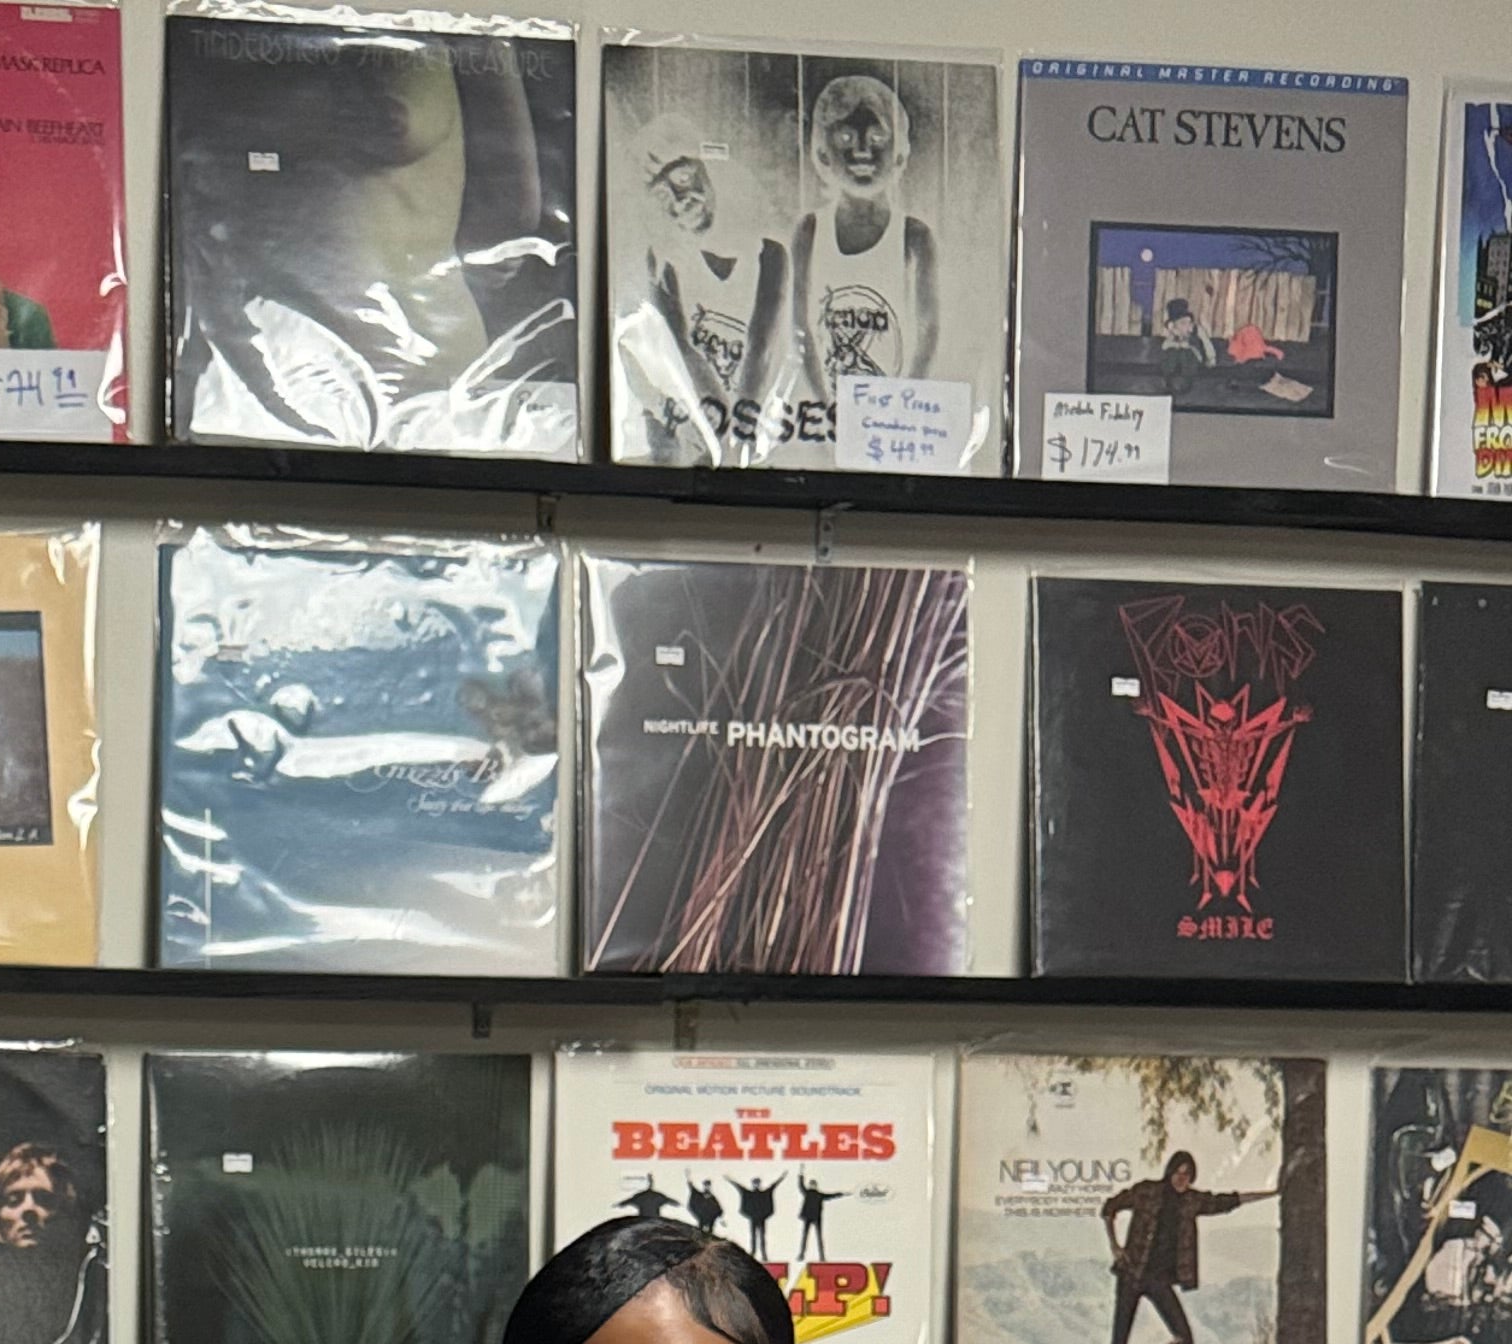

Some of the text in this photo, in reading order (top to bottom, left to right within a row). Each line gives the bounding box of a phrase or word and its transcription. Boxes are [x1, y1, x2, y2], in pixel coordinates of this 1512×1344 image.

[42, 58, 105, 75] REPLICA
[1032, 60, 1394, 92] ORIGINAL MASTER RECORDING
[1088, 104, 1348, 154] CAT STEVENS
[643, 719, 919, 753] NIGHTLIFE PHANTOGRAM
[611, 1120, 897, 1161] BEATLES
[1046, 1158, 1133, 1184] YOUNG
